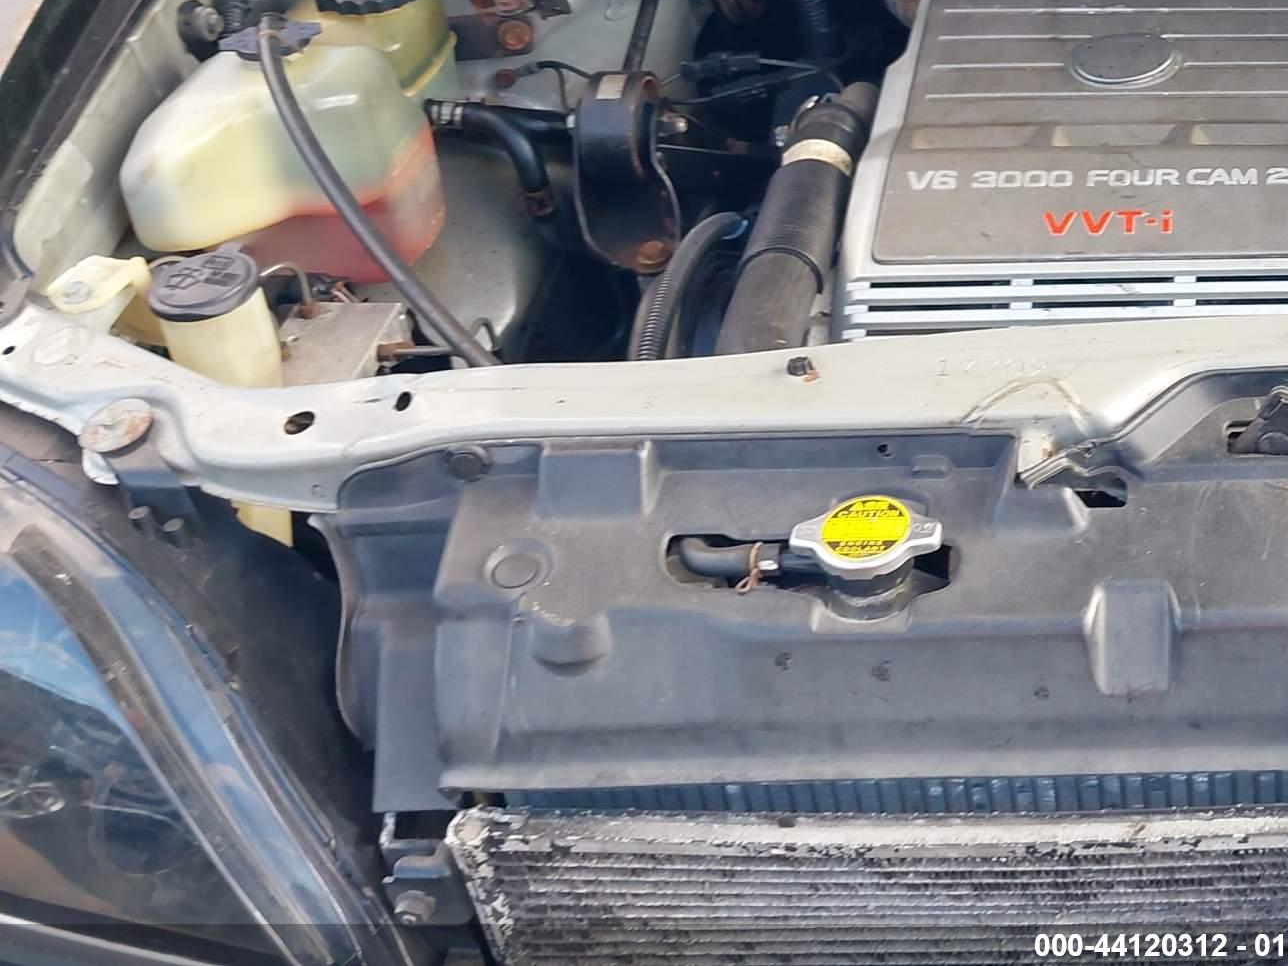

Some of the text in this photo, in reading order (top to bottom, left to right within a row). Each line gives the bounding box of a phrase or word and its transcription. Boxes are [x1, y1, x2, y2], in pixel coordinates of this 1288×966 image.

[907, 170, 958, 190] V6
[971, 169, 1074, 188] 3000
[1086, 169, 1181, 186] FOUR
[1186, 168, 1258, 186] CAM
[1043, 209, 1174, 236] VVT-i
[837, 509, 901, 518] CAUTION
